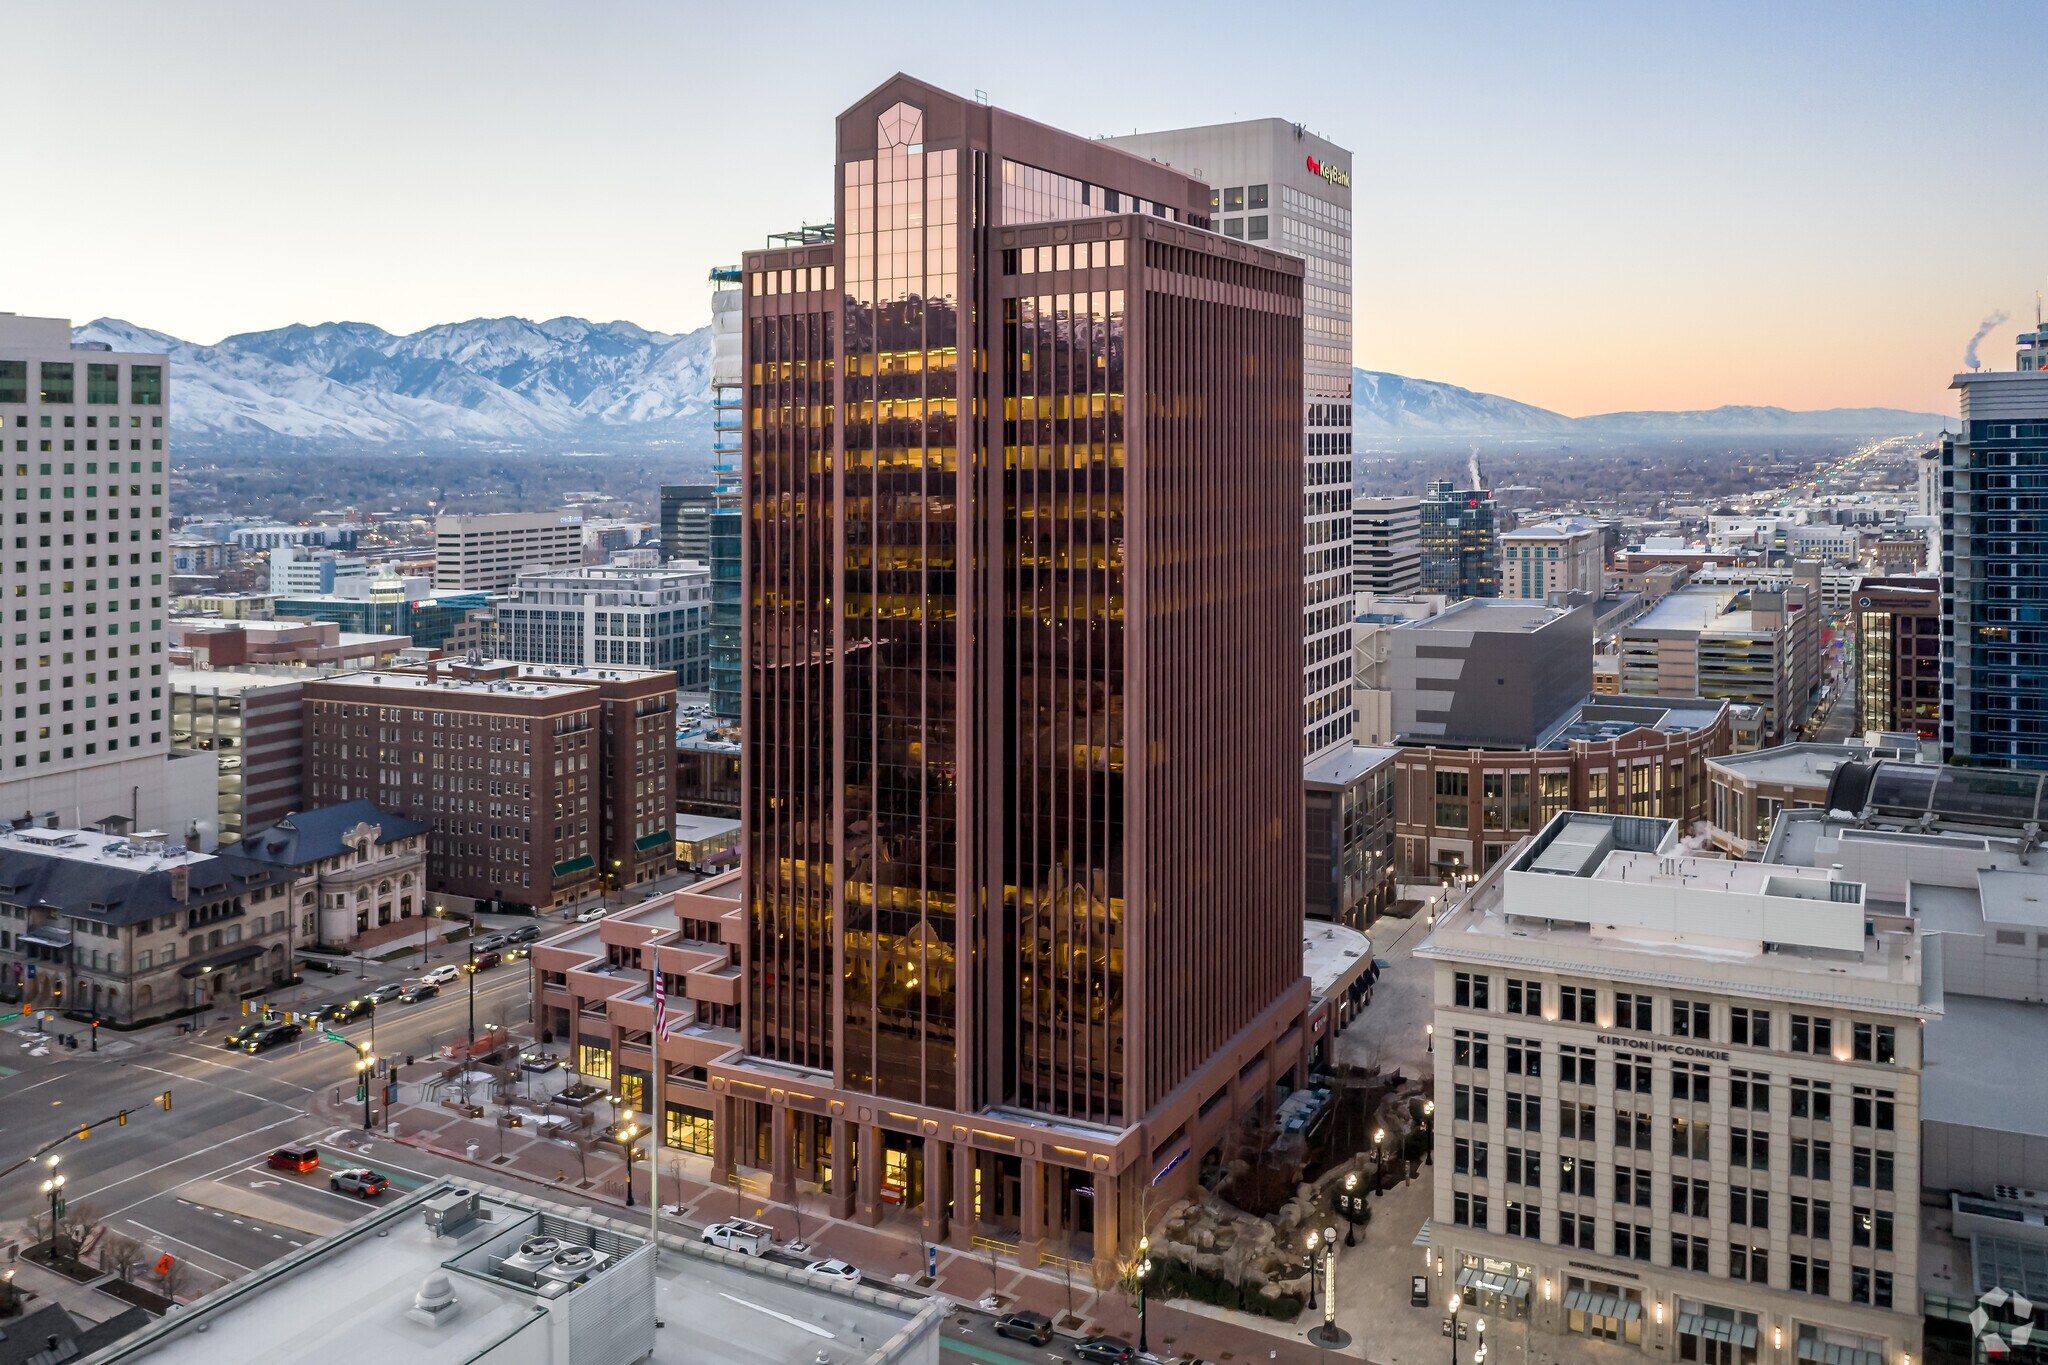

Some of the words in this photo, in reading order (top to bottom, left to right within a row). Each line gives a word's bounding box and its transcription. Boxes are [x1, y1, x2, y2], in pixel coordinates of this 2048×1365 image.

[1319, 160, 1350, 187] KeyBank
[201, 661, 209, 670] 10
[1597, 1035, 1648, 1050] KIRTON
[1568, 1261, 1597, 1272] KIRTON
